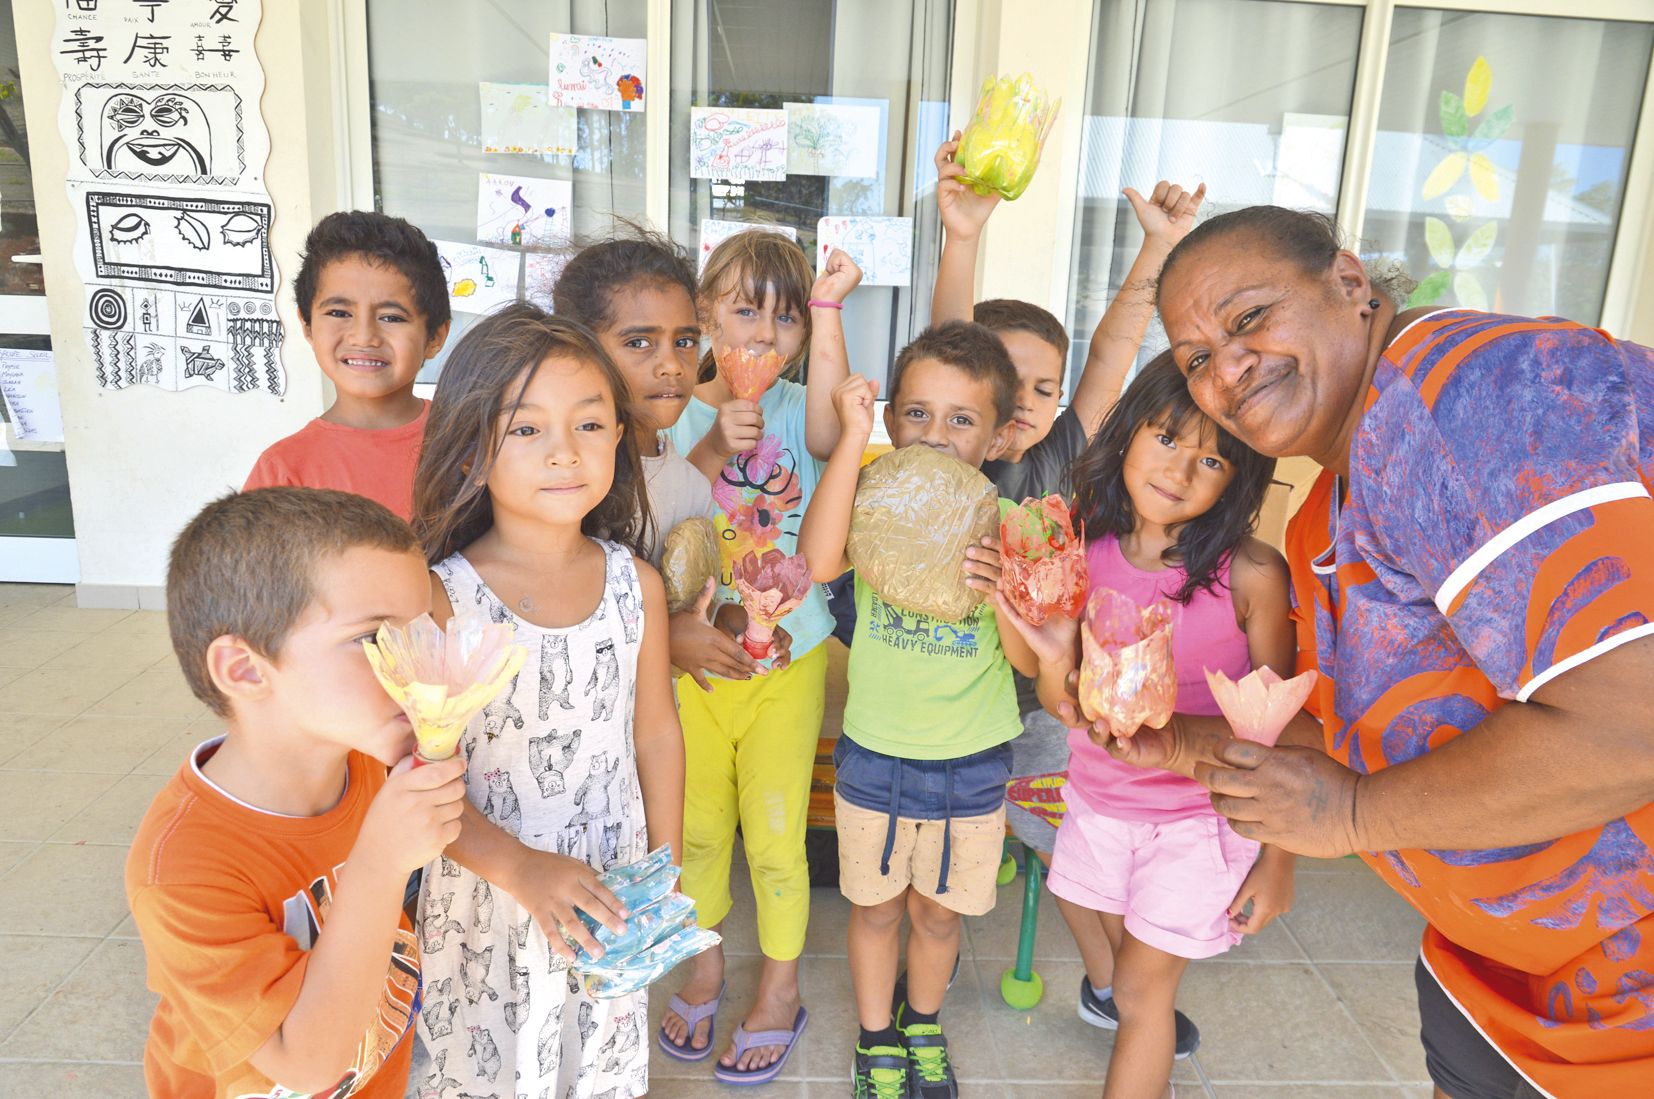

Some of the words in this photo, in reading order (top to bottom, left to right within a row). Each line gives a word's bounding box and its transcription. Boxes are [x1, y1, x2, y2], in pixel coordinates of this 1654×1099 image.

[67, 13, 97, 21] CHANCE
[122, 31, 172, 68] 康
[882, 634, 918, 652] HEAVY
[920, 641, 979, 659] EQUIPMENT
